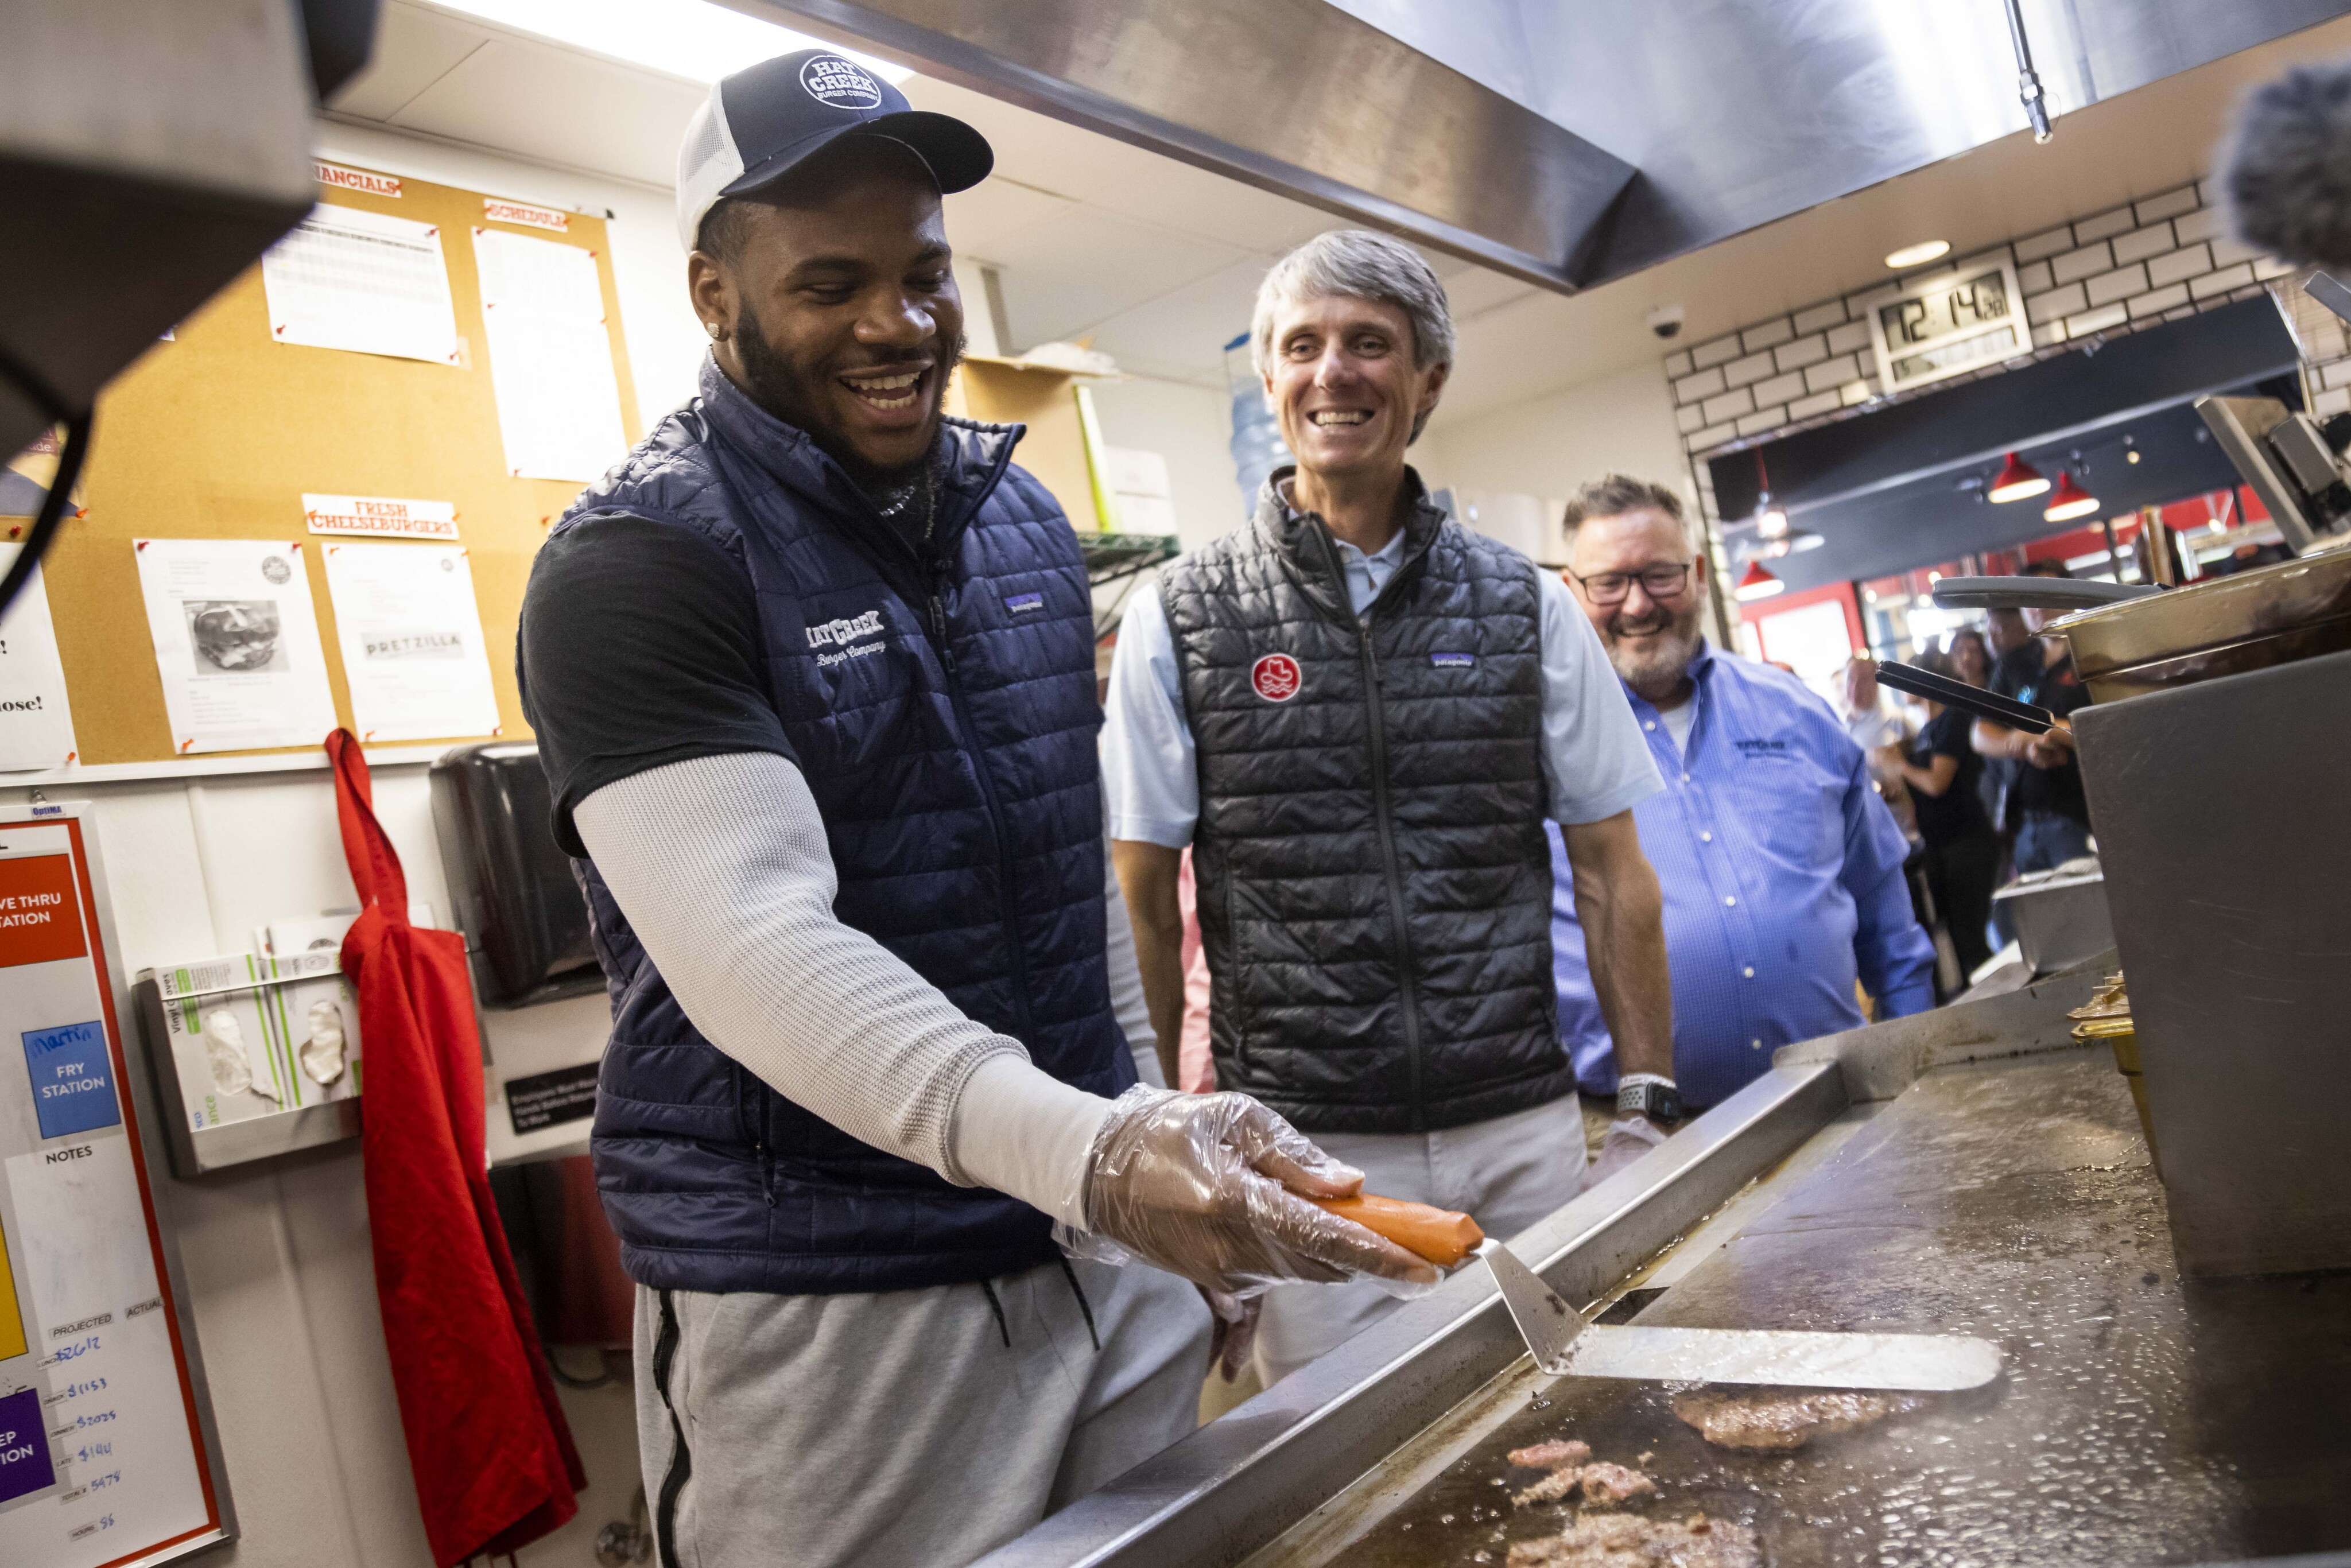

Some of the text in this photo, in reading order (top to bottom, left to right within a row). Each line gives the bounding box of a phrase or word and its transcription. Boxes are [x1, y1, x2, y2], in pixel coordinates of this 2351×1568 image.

[812, 61, 858, 77] HAT
[808, 75, 878, 94] CREEK
[817, 90, 878, 100] BURGER COMPANY
[355, 501, 408, 517] FRESH
[311, 515, 452, 534] CHEESEBURGERS
[367, 635, 461, 656] PRETZILLA
[817, 641, 887, 667] Burger Company
[0, 695, 43, 712] ose!
[18, 892, 61, 908] THRU
[56, 1062, 85, 1078] FRY
[41, 1076, 106, 1099] STATION
[46, 1146, 93, 1165] NOTES
[53, 1299, 162, 1338] PROJECTED ACTUAL
[1, 1444, 34, 1465] ION
